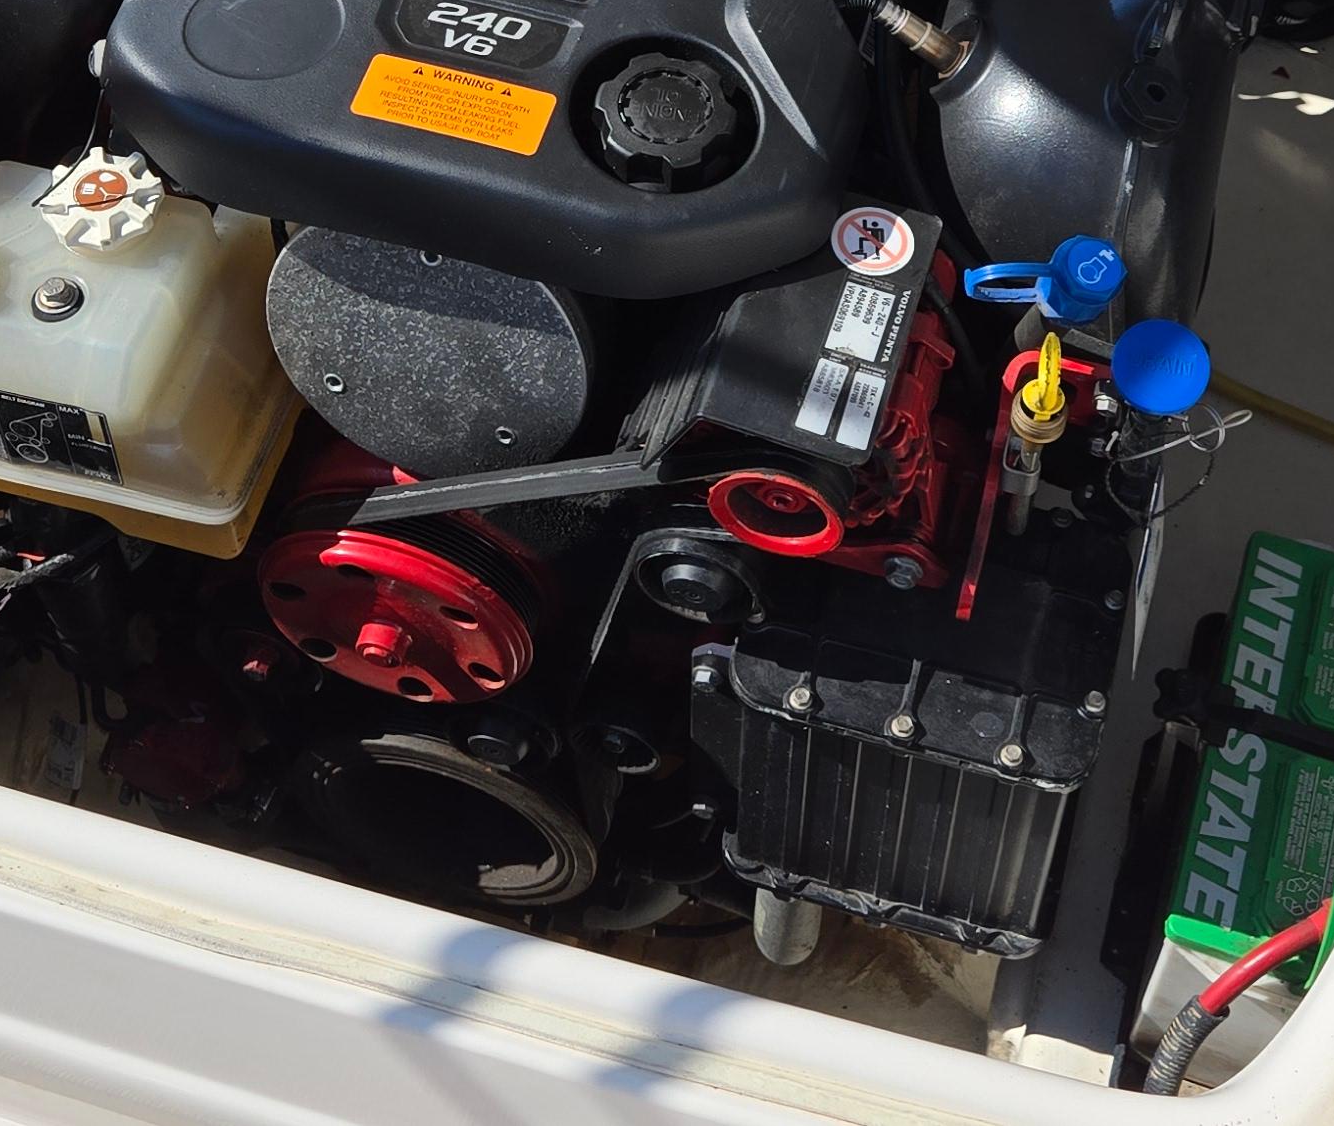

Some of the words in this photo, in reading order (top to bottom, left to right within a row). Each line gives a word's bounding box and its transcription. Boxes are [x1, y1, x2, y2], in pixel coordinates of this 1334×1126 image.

[427, 2, 532, 41] 240
[444, 28, 498, 57] V6
[384, 75, 410, 87] AVOID
[411, 80, 450, 95] SERIOUS
[453, 88, 483, 101] INJURY
[486, 97, 499, 106] OR
[501, 101, 530, 114] DEATH
[433, 70, 495, 91] WARNING
[380, 90, 428, 108] RESULTING
[430, 100, 456, 113] FROM
[458, 107, 496, 123] LEAKING
[382, 100, 420, 116] INSPECT
[421, 108, 463, 124] SYSTEMS
[465, 118, 483, 128] FOR
[484, 123, 513, 136] LEAKS
[397, 86, 425, 98] FROM
[427, 92, 444, 102] FIRE
[447, 96, 460, 105] OR
[462, 100, 512, 118] EXPLOSION
[387, 109, 415, 121] PRIOR
[417, 115, 429, 124] TO
[430, 118, 460, 132] USAGE
[462, 125, 475, 134] OF
[477, 128, 500, 141] BOAT
[893, 290, 912, 325] VOLVO
[880, 324, 900, 363] PENTA
[15, 396, 46, 410] DIAGRAM
[57, 405, 80, 415] MAX
